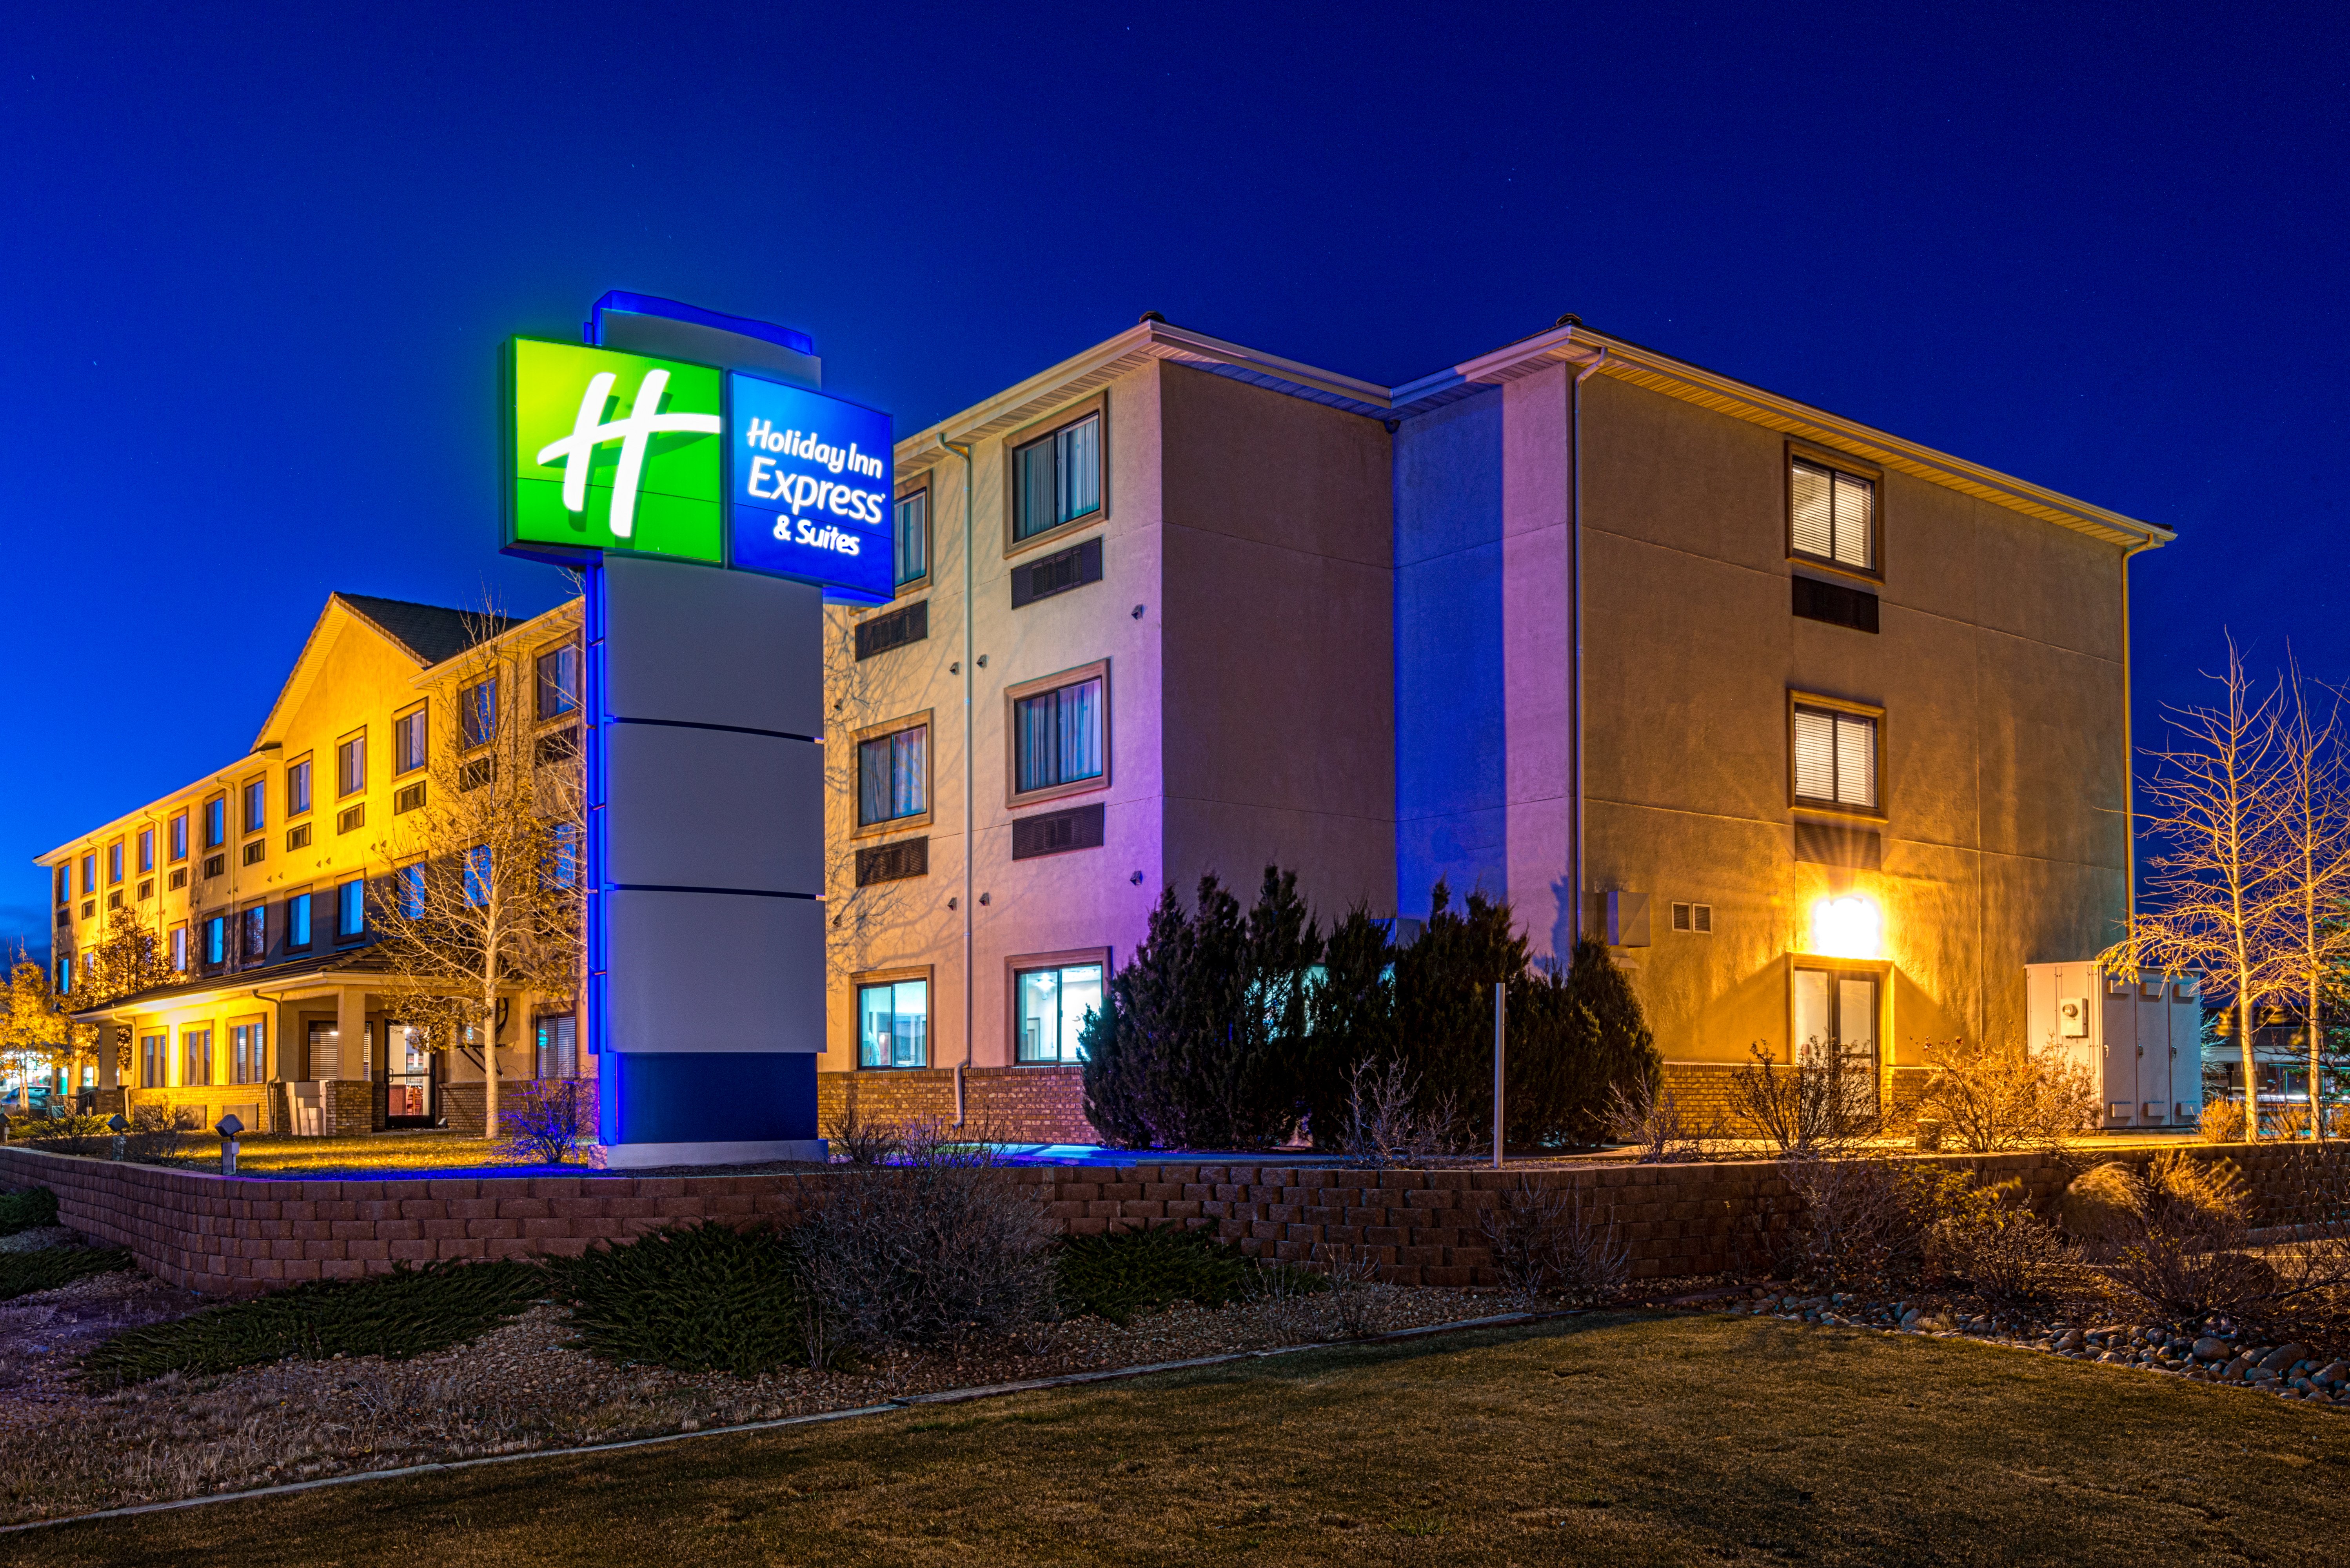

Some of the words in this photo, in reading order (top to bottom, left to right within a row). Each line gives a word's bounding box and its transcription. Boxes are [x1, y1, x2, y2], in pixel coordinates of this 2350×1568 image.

[747, 418, 846, 473] Holiday
[848, 443, 883, 479] Inn
[748, 456, 883, 524] Express
[773, 515, 791, 541] &
[795, 519, 860, 555] Suites
